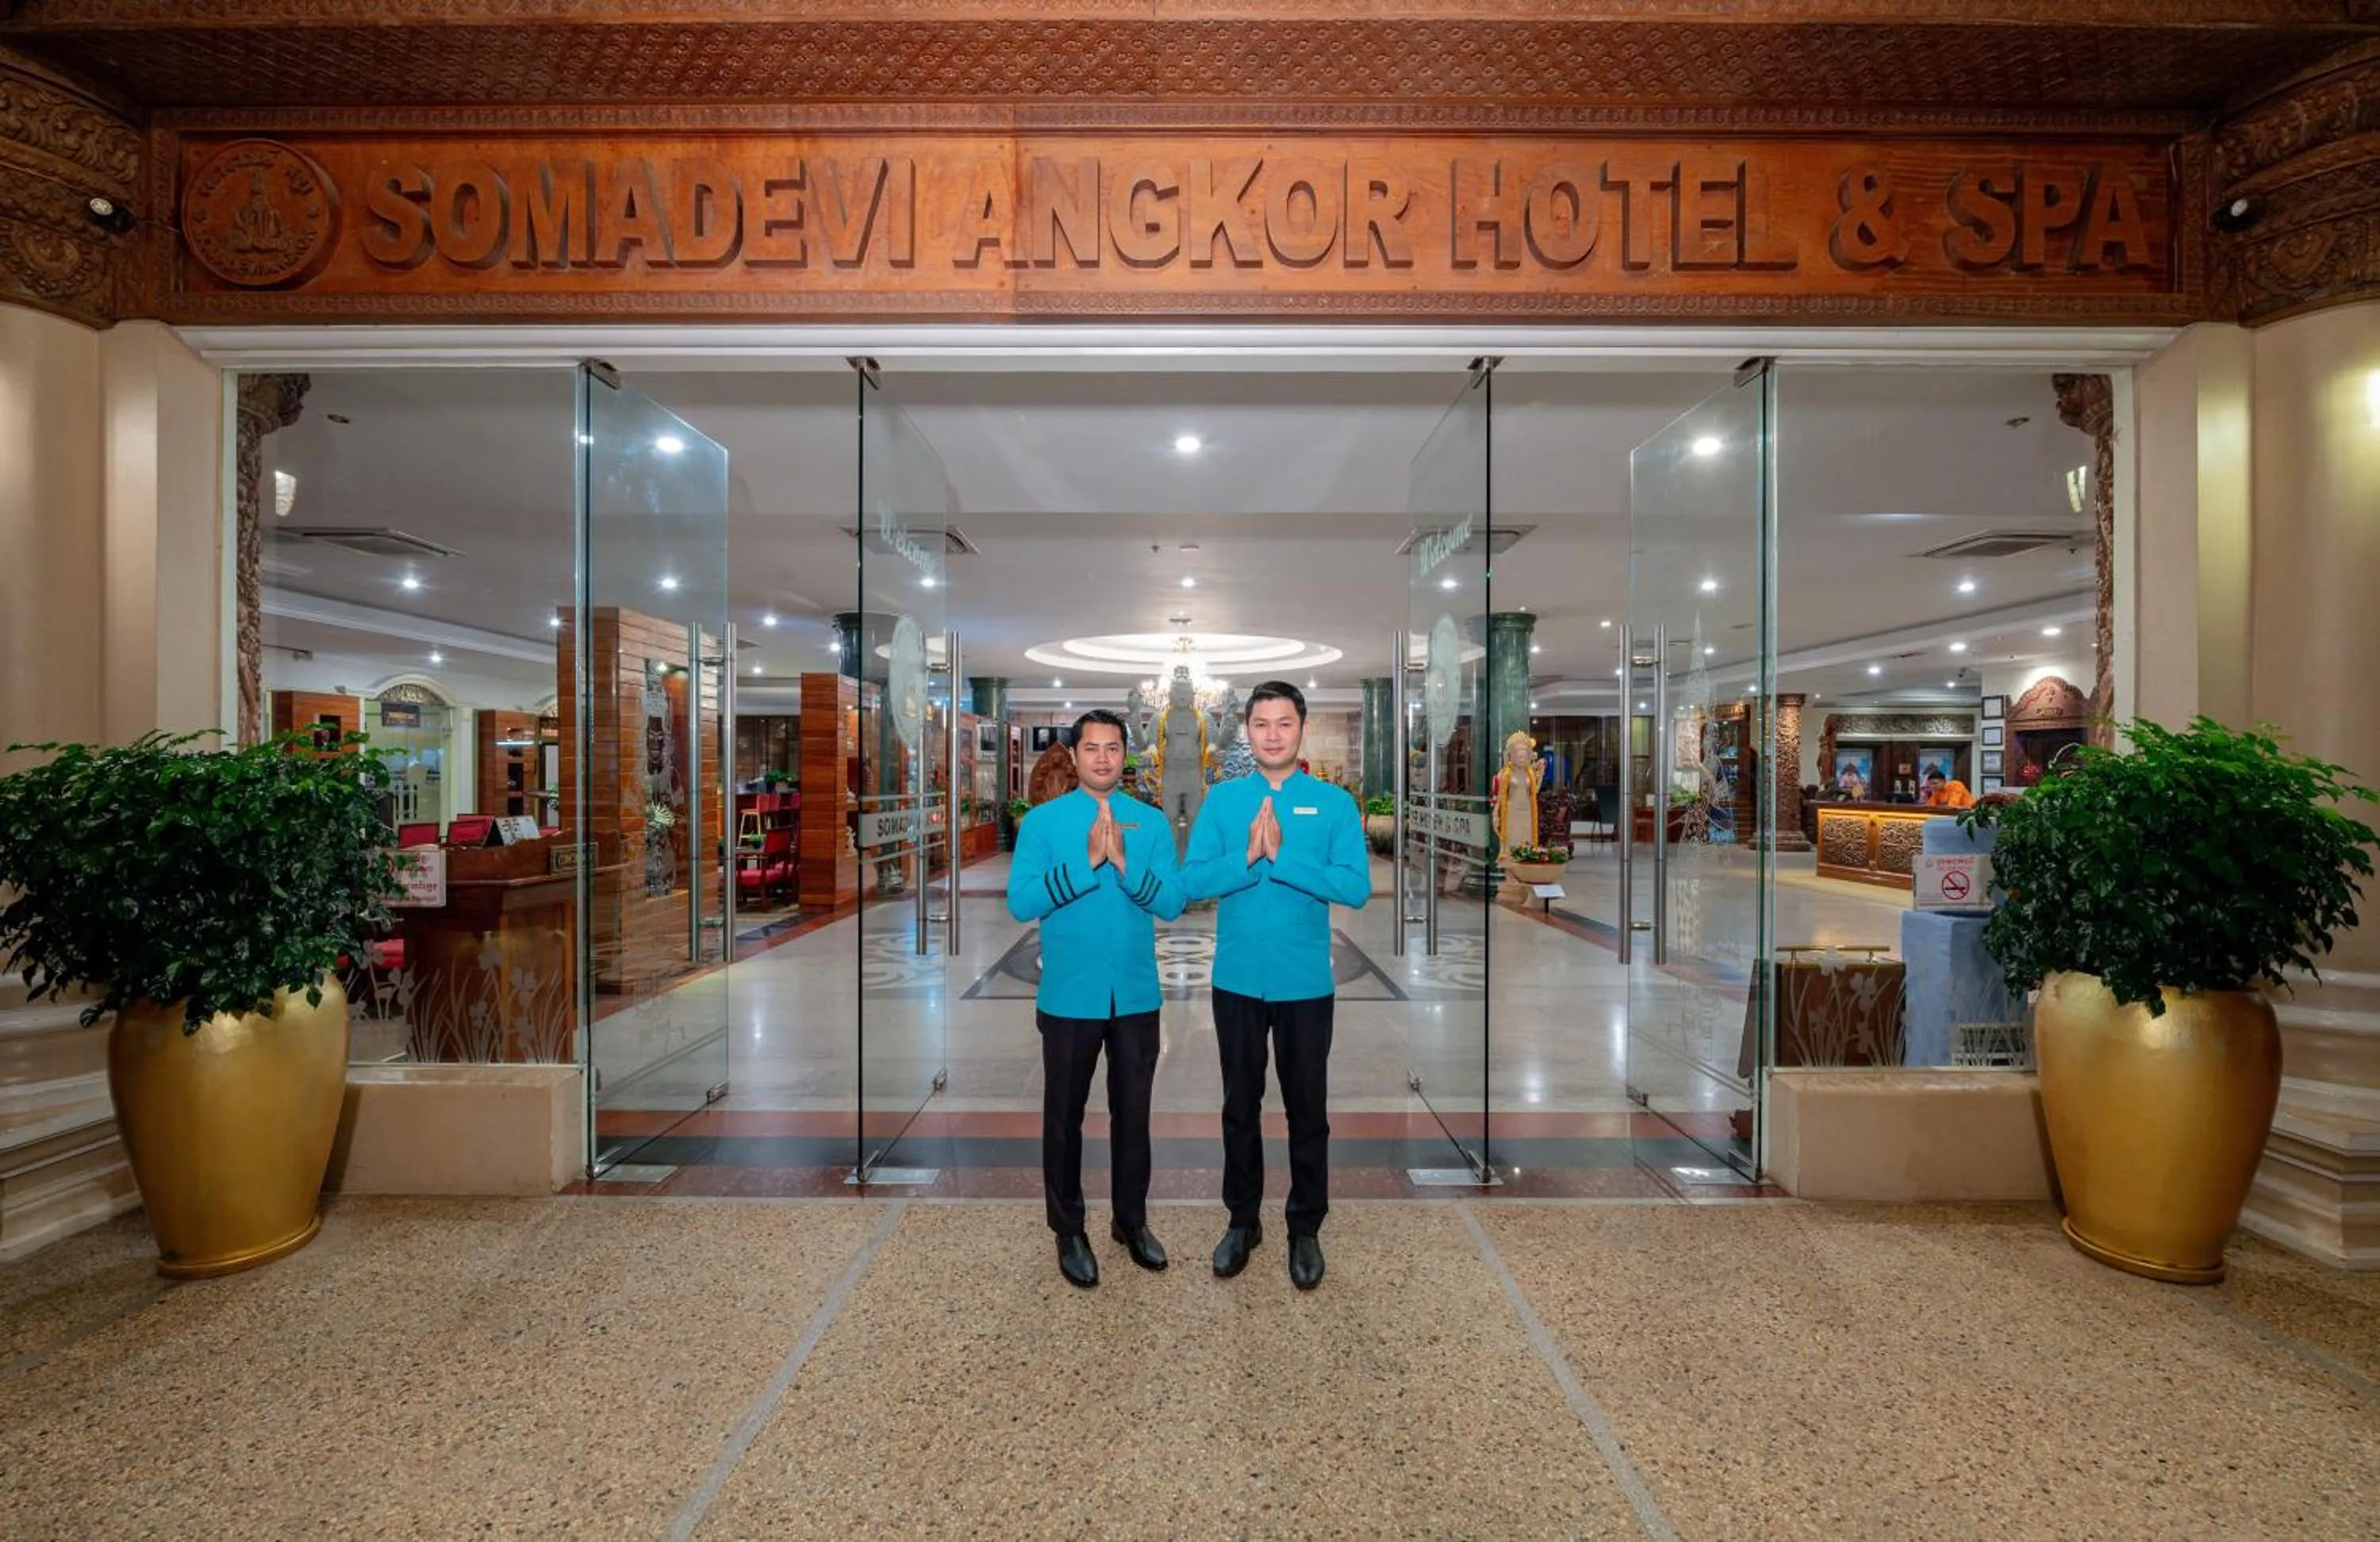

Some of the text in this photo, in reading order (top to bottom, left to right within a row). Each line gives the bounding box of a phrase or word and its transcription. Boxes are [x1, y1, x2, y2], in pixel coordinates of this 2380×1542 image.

[362, 158, 916, 270] SOMADEVI
[954, 158, 1415, 270] ANGKOR
[1450, 158, 1798, 271] HOTEL
[1829, 161, 1905, 272] &
[1943, 161, 2152, 275] SPA
